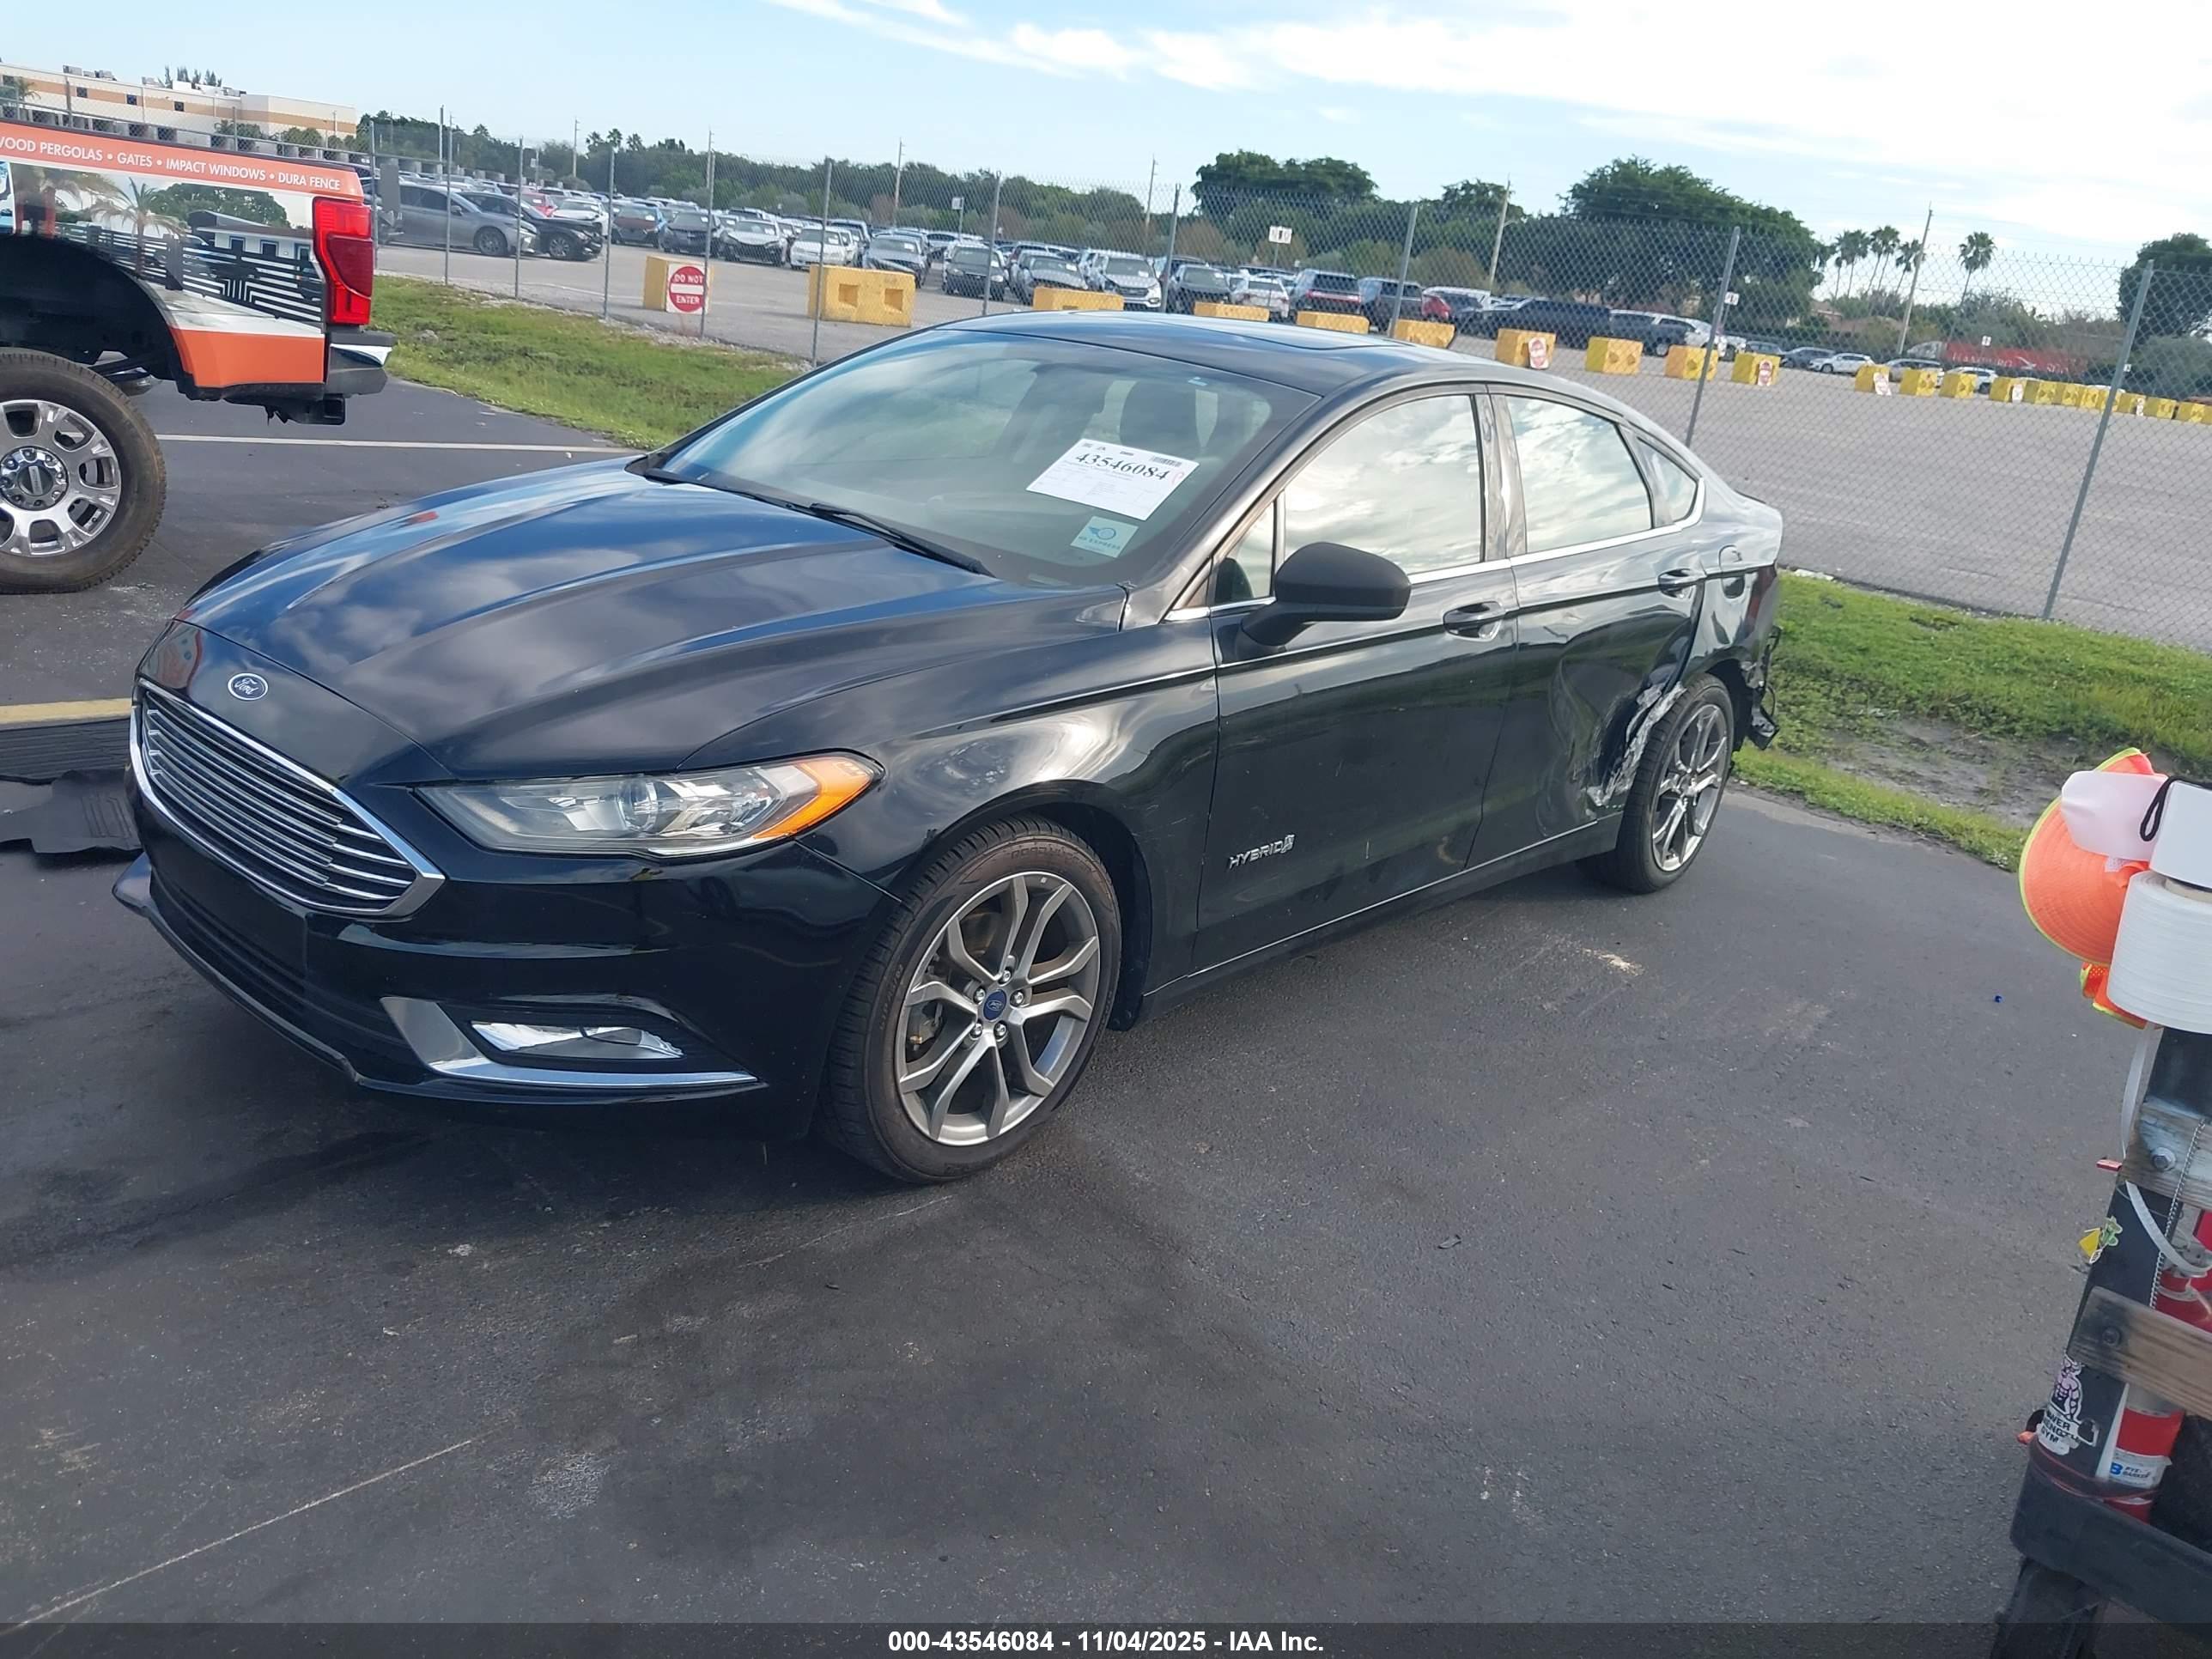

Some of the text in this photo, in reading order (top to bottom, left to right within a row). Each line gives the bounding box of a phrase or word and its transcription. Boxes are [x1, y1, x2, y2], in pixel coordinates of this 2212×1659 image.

[40, 142, 103, 161] PERGOLAS
[117, 152, 153, 167] GATES
[166, 158, 266, 180] IMPACT WINDOWS
[278, 173, 341, 191] DURA FENCE
[674, 274, 703, 284] DO NOT
[676, 295, 700, 305] ENTER
[1075, 453, 1170, 480] 43546084
[1229, 840, 1284, 869] HYBRID
